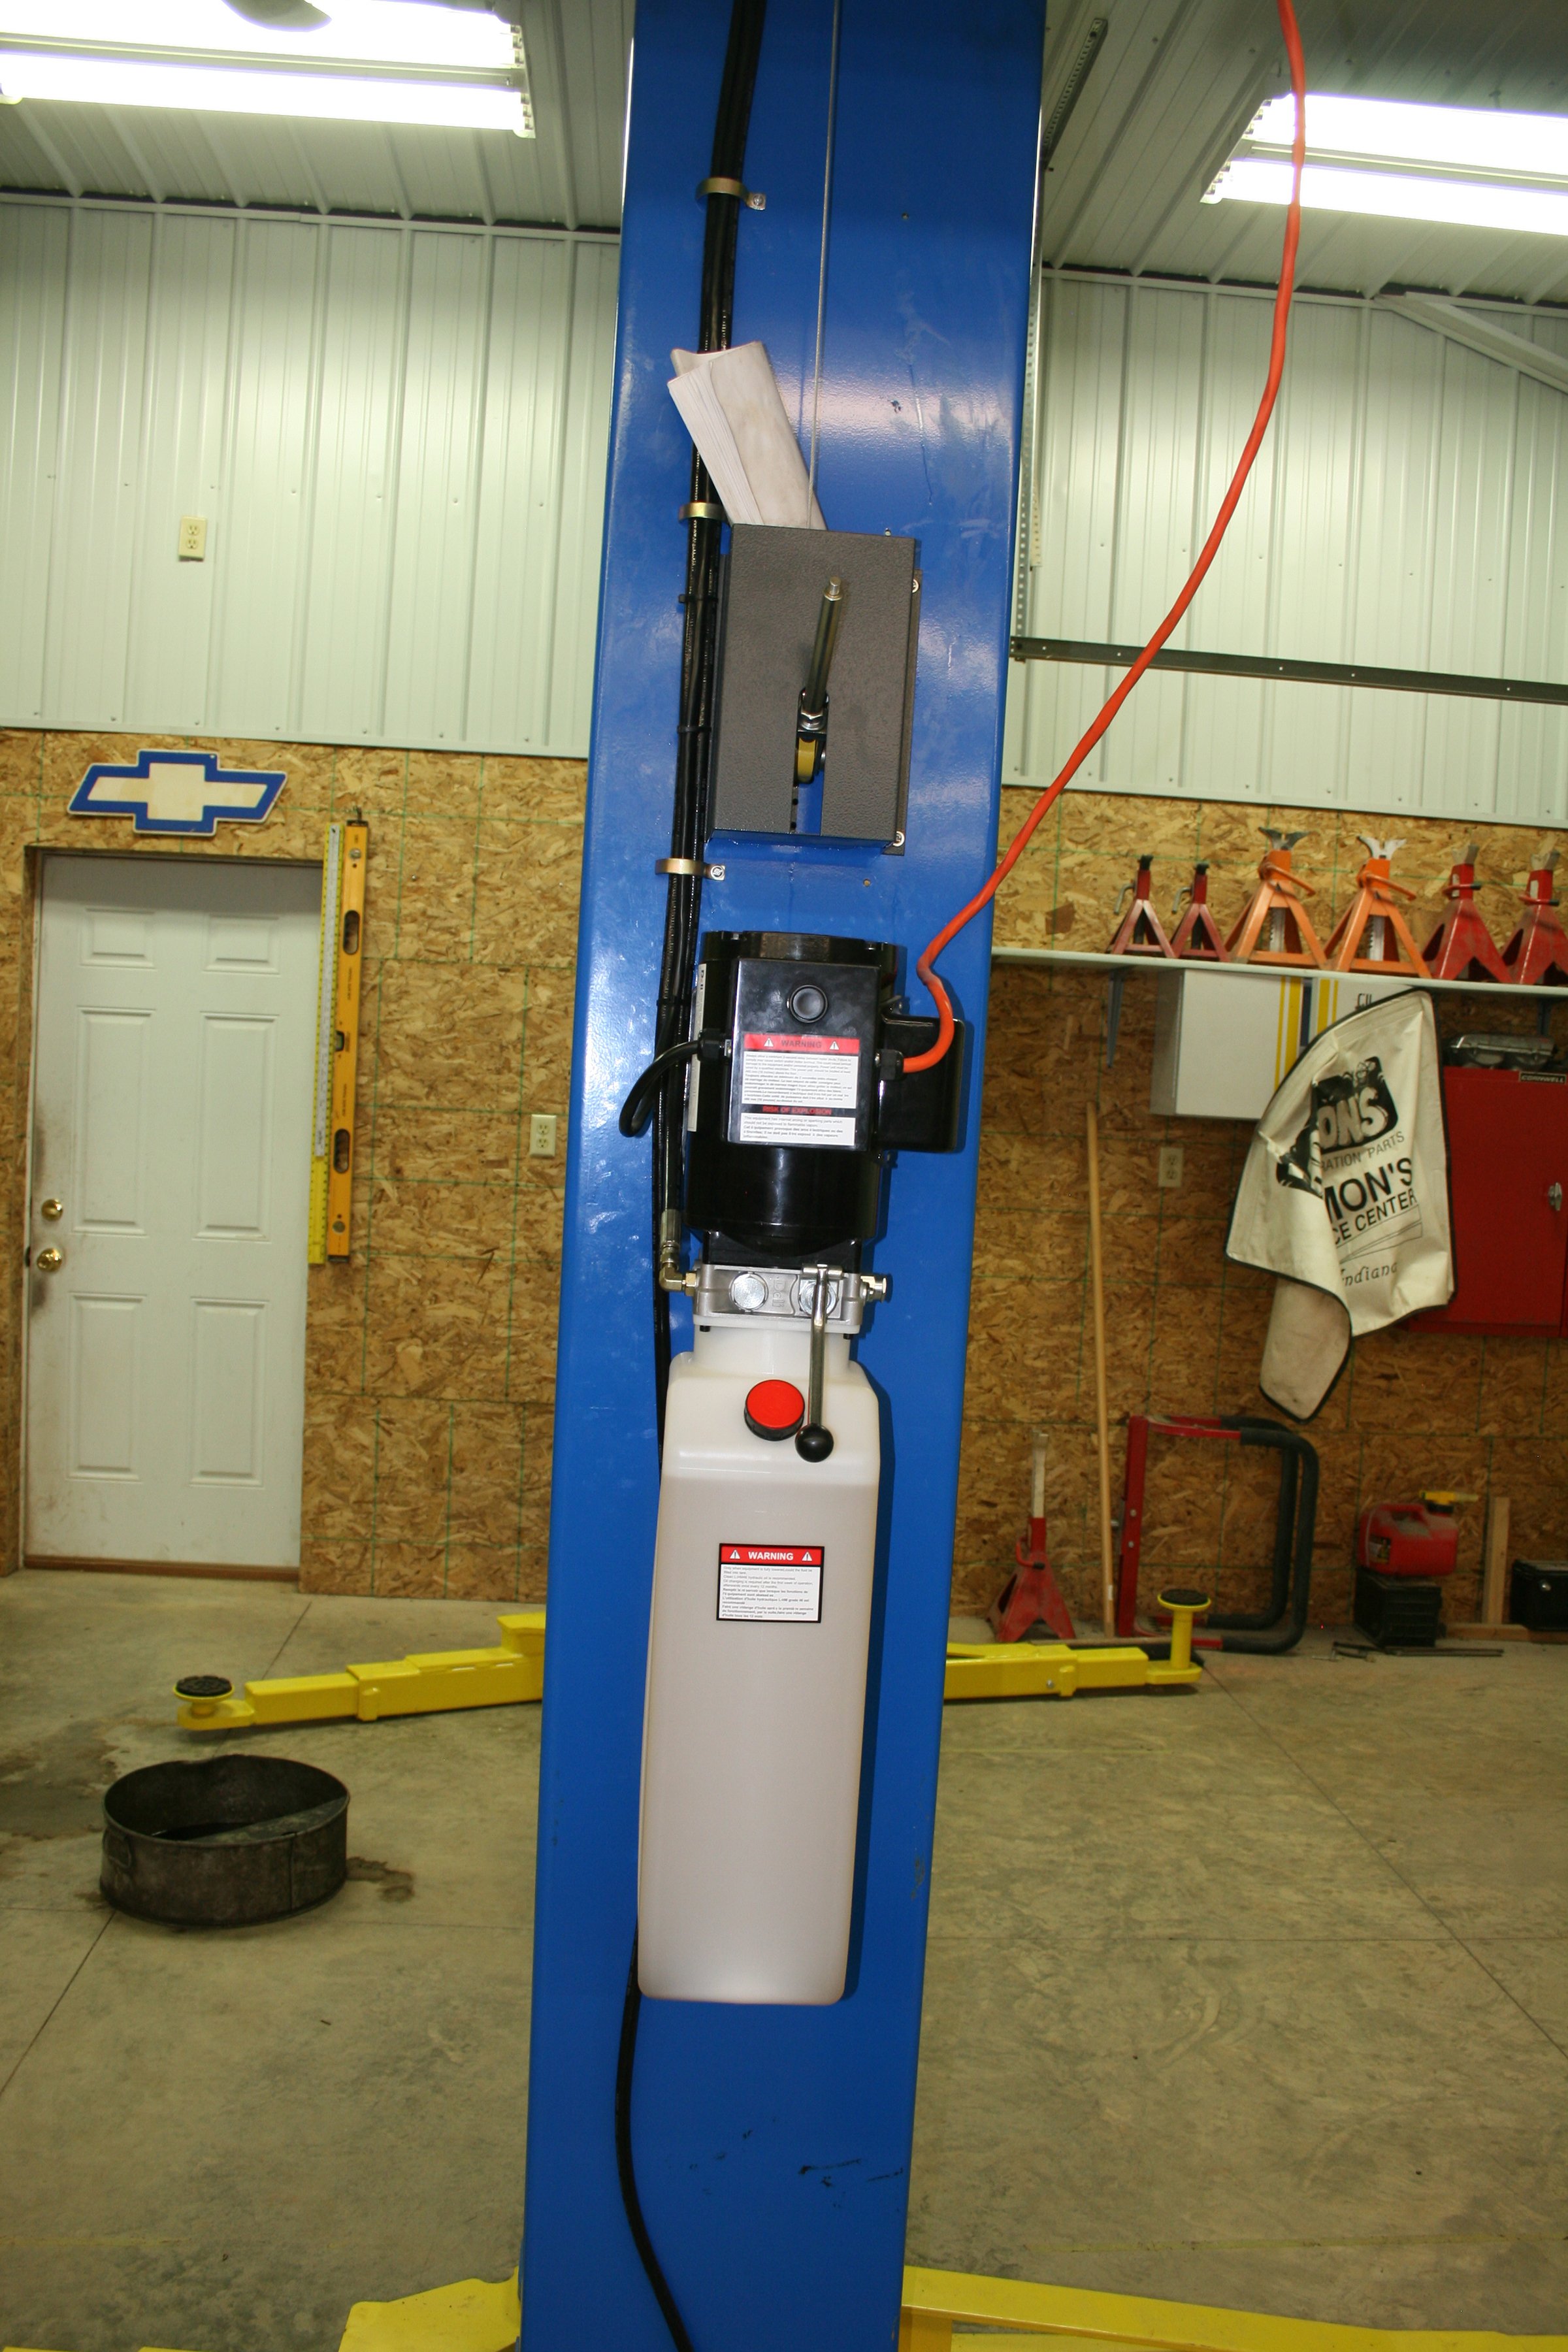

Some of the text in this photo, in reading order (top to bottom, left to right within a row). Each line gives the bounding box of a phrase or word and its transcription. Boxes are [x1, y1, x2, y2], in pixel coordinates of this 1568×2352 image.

[781, 1039, 822, 1049] WARNING
[1521, 1074, 1564, 1083] CORNWELL
[791, 1107, 832, 1115] EXPLOSION
[1368, 1131, 1405, 1158] PARTS
[1356, 1188, 1417, 1231] CENTER
[748, 1551, 794, 1561] WARNING
